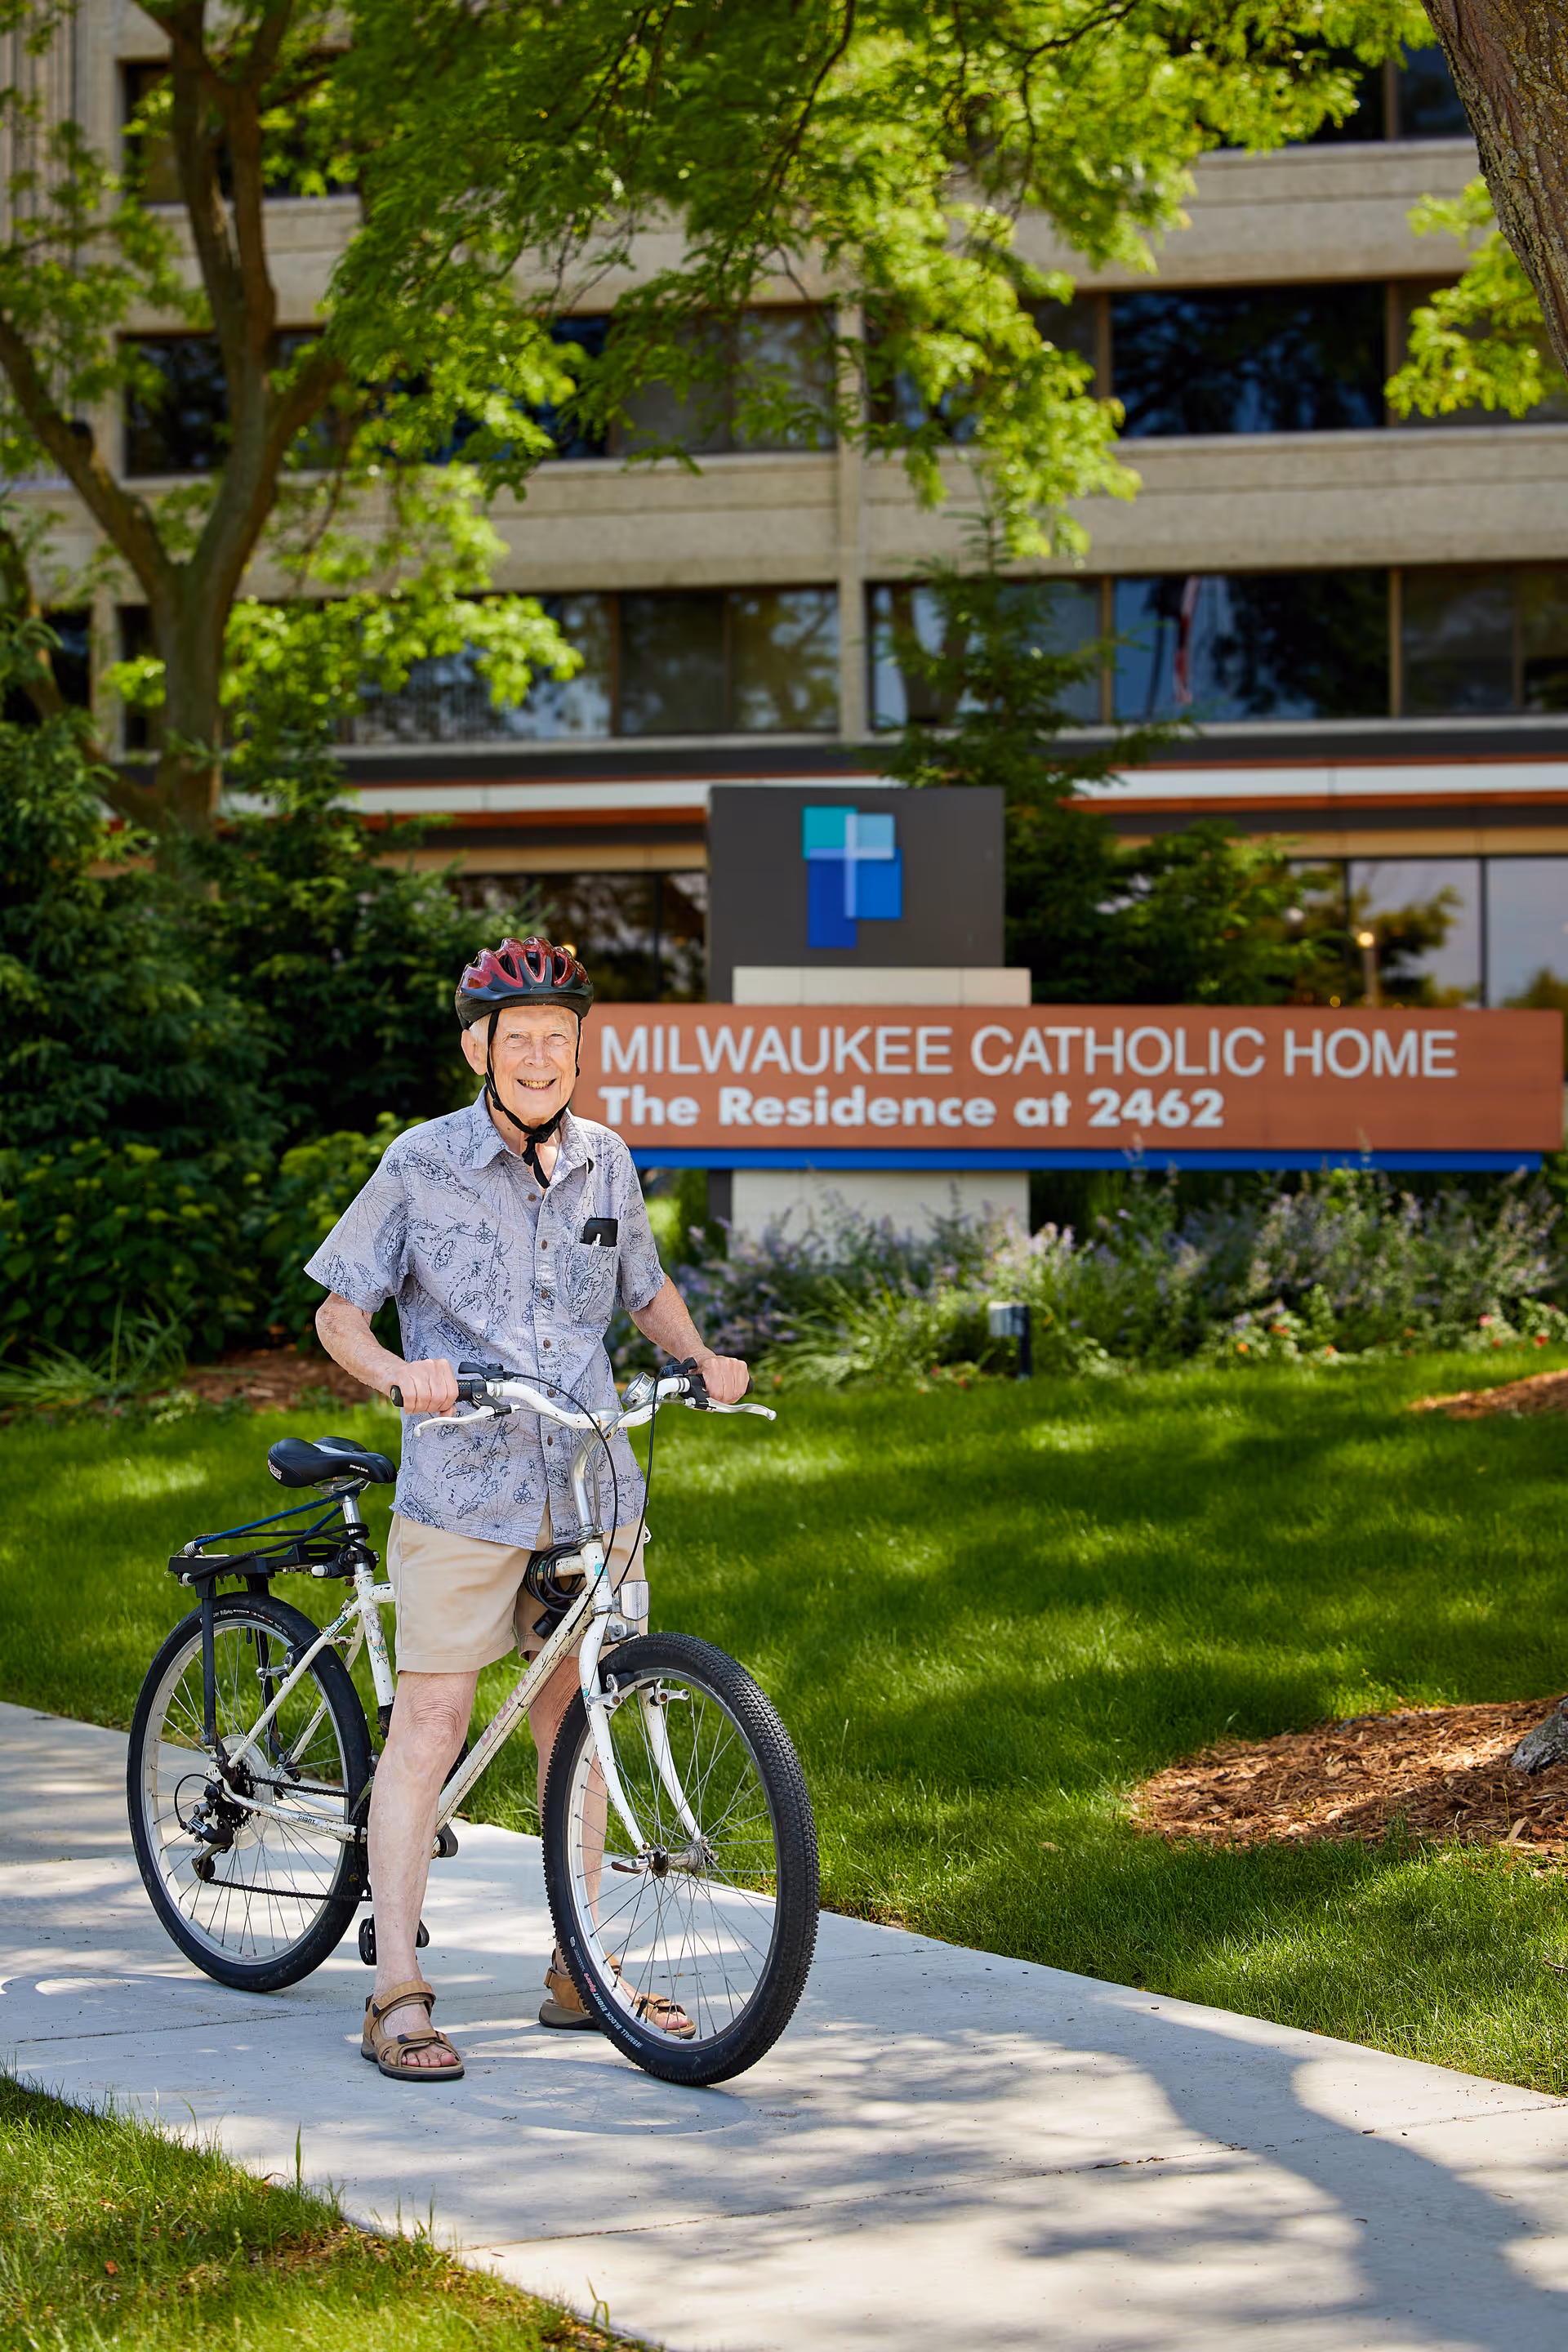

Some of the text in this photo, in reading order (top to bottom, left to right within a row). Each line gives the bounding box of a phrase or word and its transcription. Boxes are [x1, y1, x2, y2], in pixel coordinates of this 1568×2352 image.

[601, 1026, 1457, 1077] MILWAUKEE CATHOLIC HOME
[599, 1085, 1224, 1127] The Residence at 2462
[592, 1993, 608, 2012] EIGHT
[604, 2011, 622, 2030] BLOCK
[621, 2029, 639, 2047] SMALL
